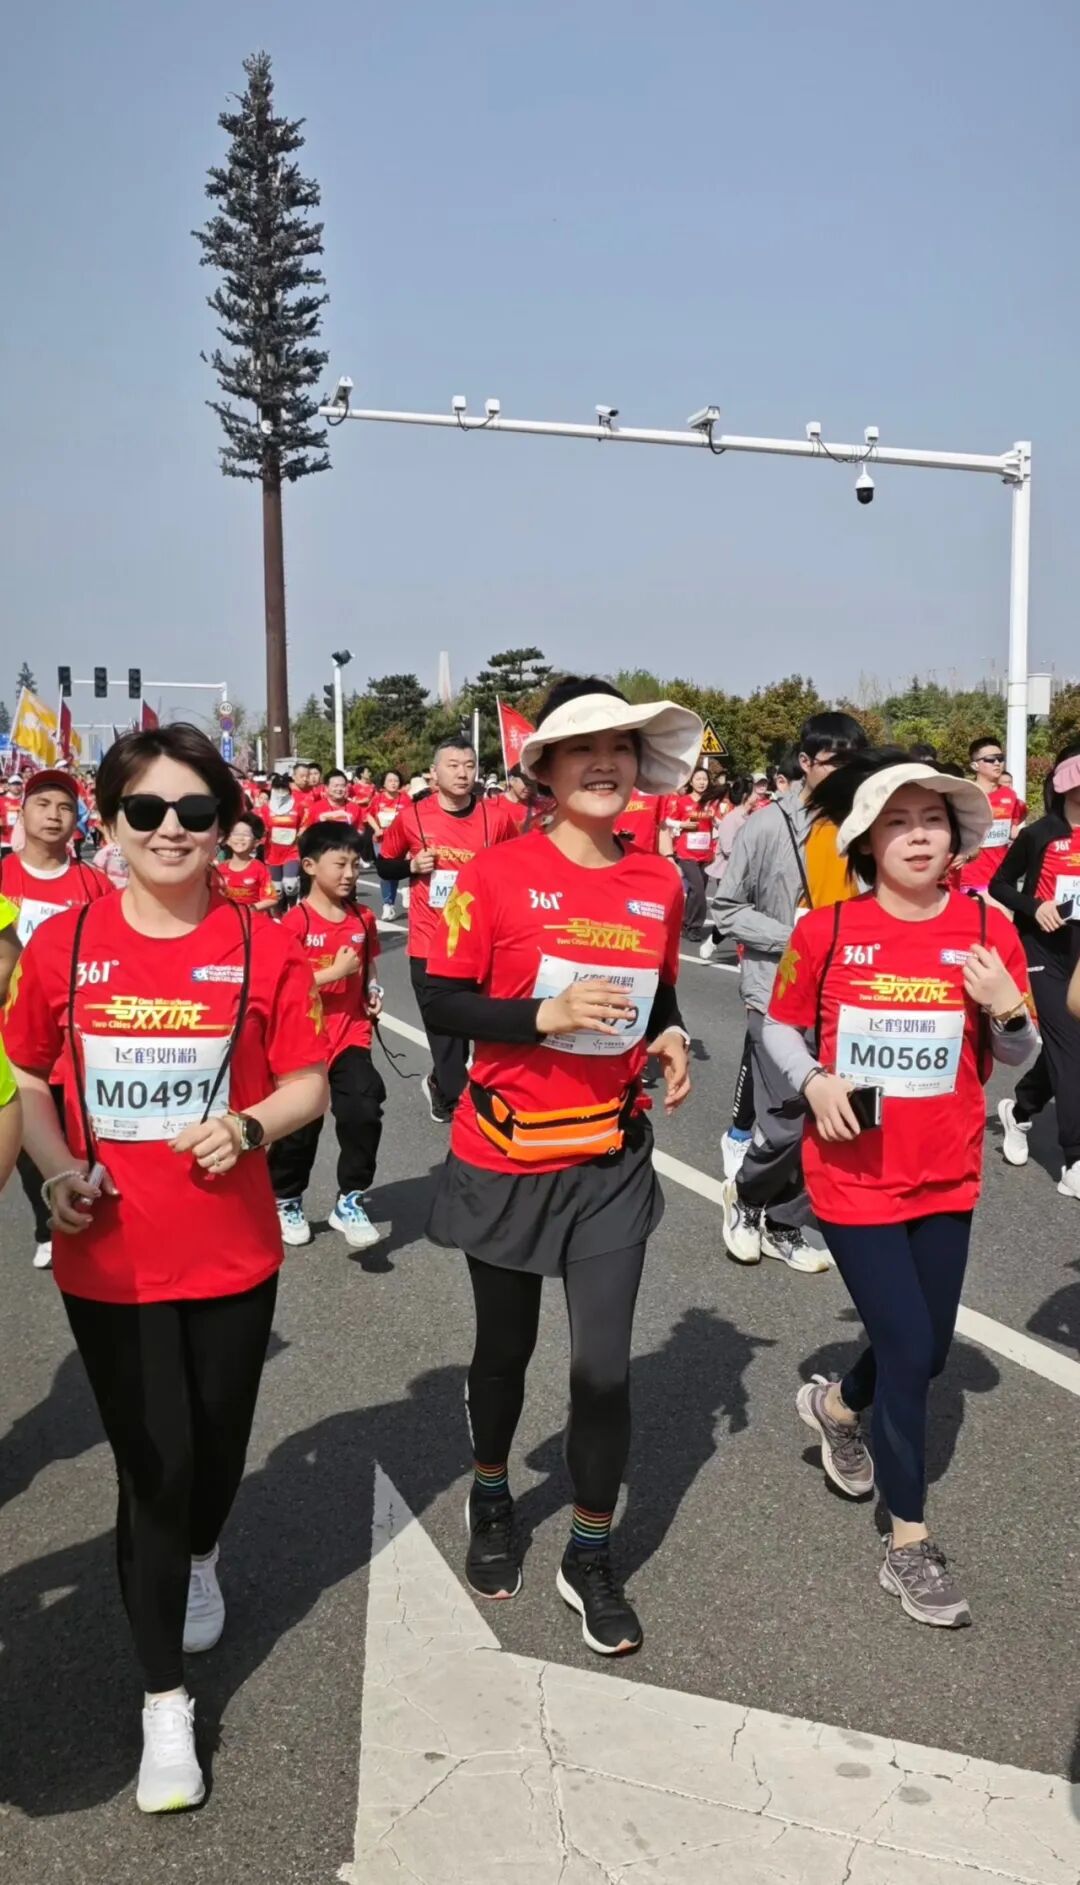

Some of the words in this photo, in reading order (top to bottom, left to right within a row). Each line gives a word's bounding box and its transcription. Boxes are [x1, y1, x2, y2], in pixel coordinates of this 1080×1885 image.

[843, 943, 881, 965] 361°
[868, 1018, 936, 1033] 飞鹤奶粉
[115, 1047, 197, 1064] 飞鹤奶粉
[850, 1042, 949, 1070] M0568
[96, 1079, 211, 1109] M0491
